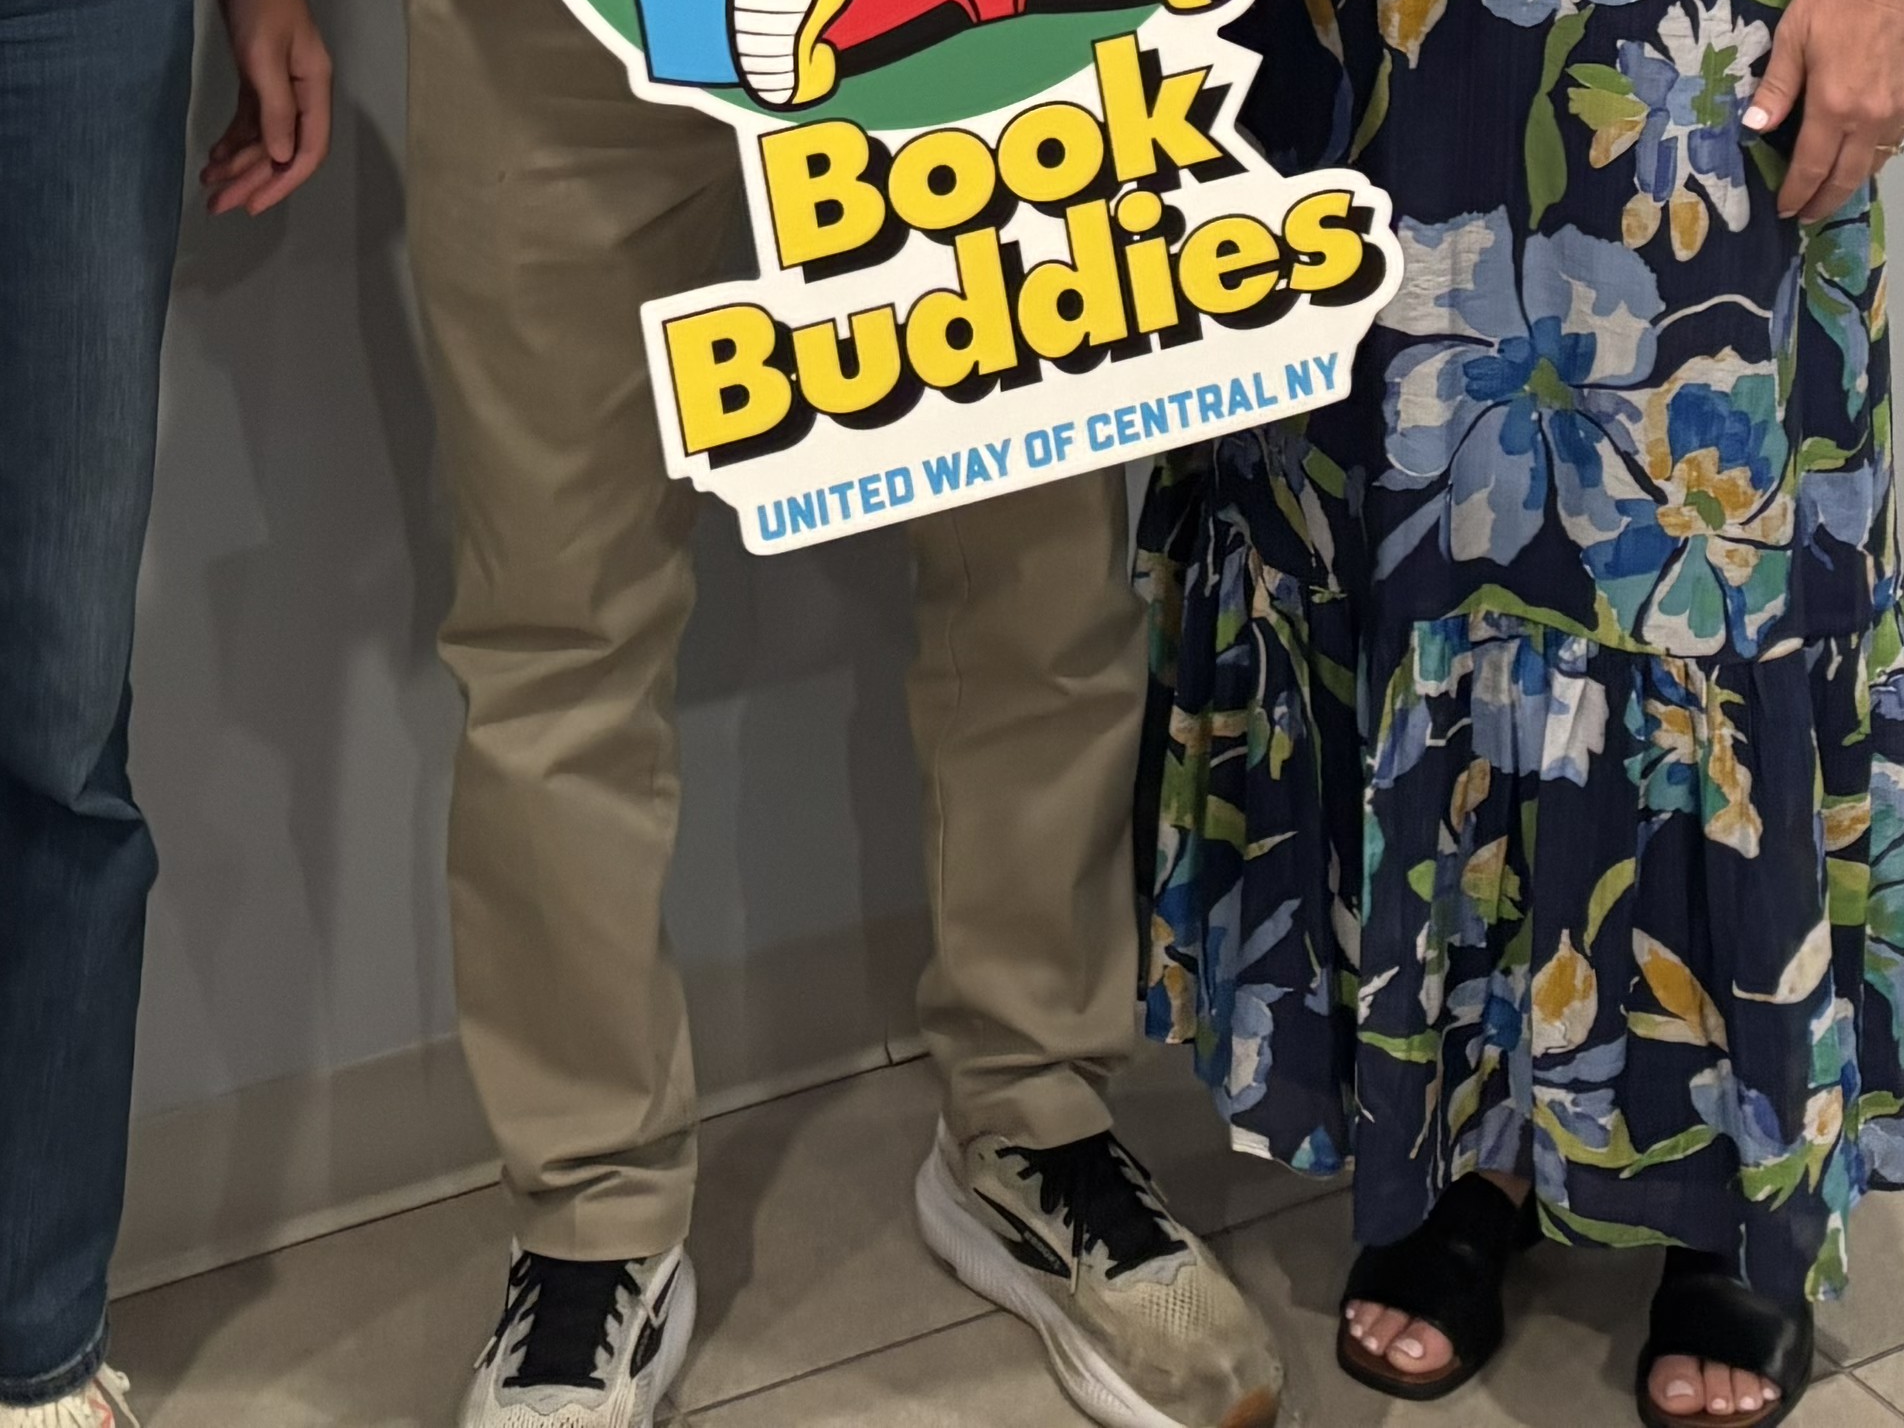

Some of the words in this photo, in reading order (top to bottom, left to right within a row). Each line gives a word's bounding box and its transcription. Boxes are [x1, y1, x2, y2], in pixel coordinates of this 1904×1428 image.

[756, 31, 1236, 280] Book
[662, 189, 1378, 464] Buddies
[757, 464, 916, 542] UNITED
[924, 437, 1014, 497] WAY
[1024, 421, 1076, 470] OF
[1087, 379, 1279, 459] CENTRAL
[1284, 352, 1341, 406] NY
